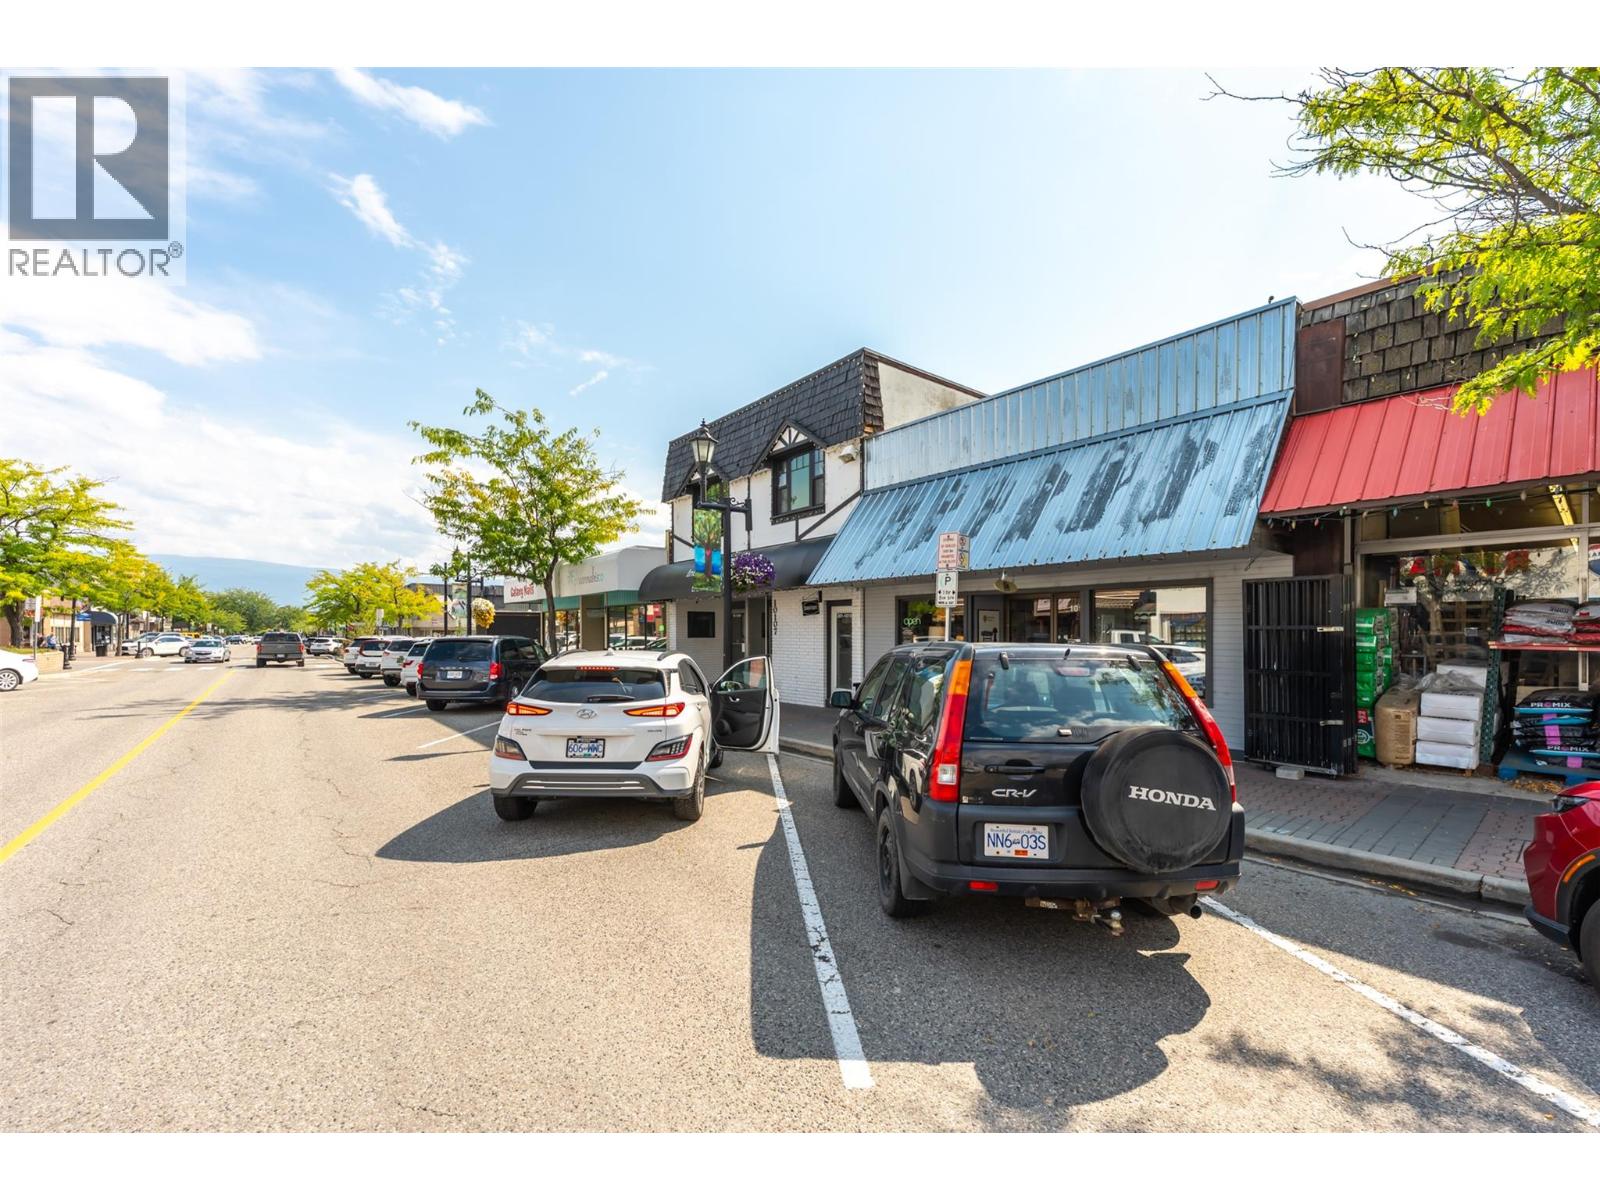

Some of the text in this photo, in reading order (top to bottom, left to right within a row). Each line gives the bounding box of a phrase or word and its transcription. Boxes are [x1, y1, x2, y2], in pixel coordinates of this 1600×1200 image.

[903, 617, 921, 627] open
[569, 743, 583, 753] 606
[991, 788, 1037, 798] CR-V
[1128, 785, 1217, 811] HONDA
[987, 832, 1046, 850] NN6 03S
